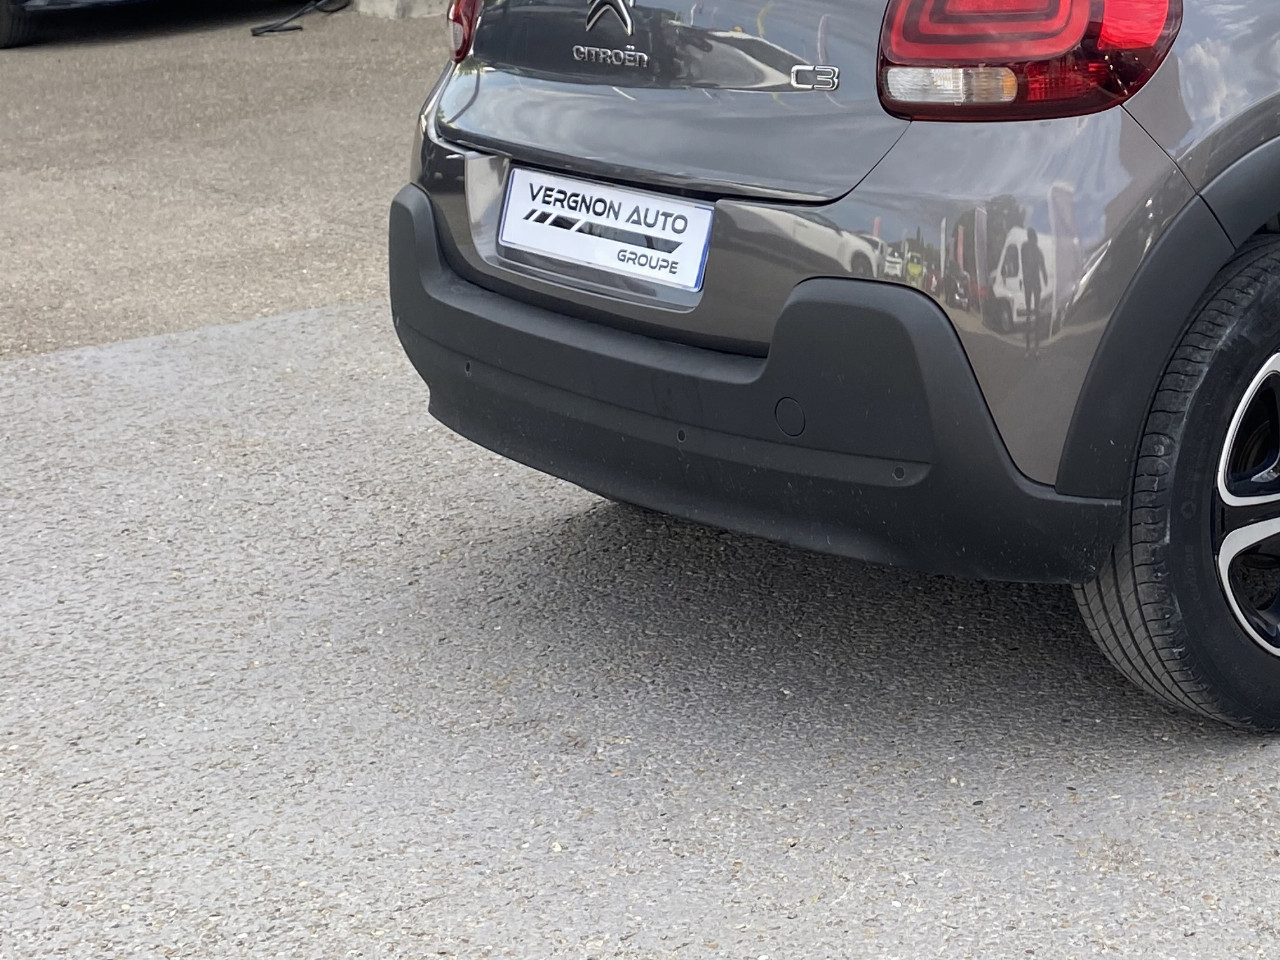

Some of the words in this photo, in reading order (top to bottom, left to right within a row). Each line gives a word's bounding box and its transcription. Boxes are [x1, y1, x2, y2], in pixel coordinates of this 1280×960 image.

[790, 64, 840, 91] C3
[528, 182, 622, 222] VERGNON
[625, 204, 689, 234] AUTO
[617, 249, 679, 275] GROUPE
